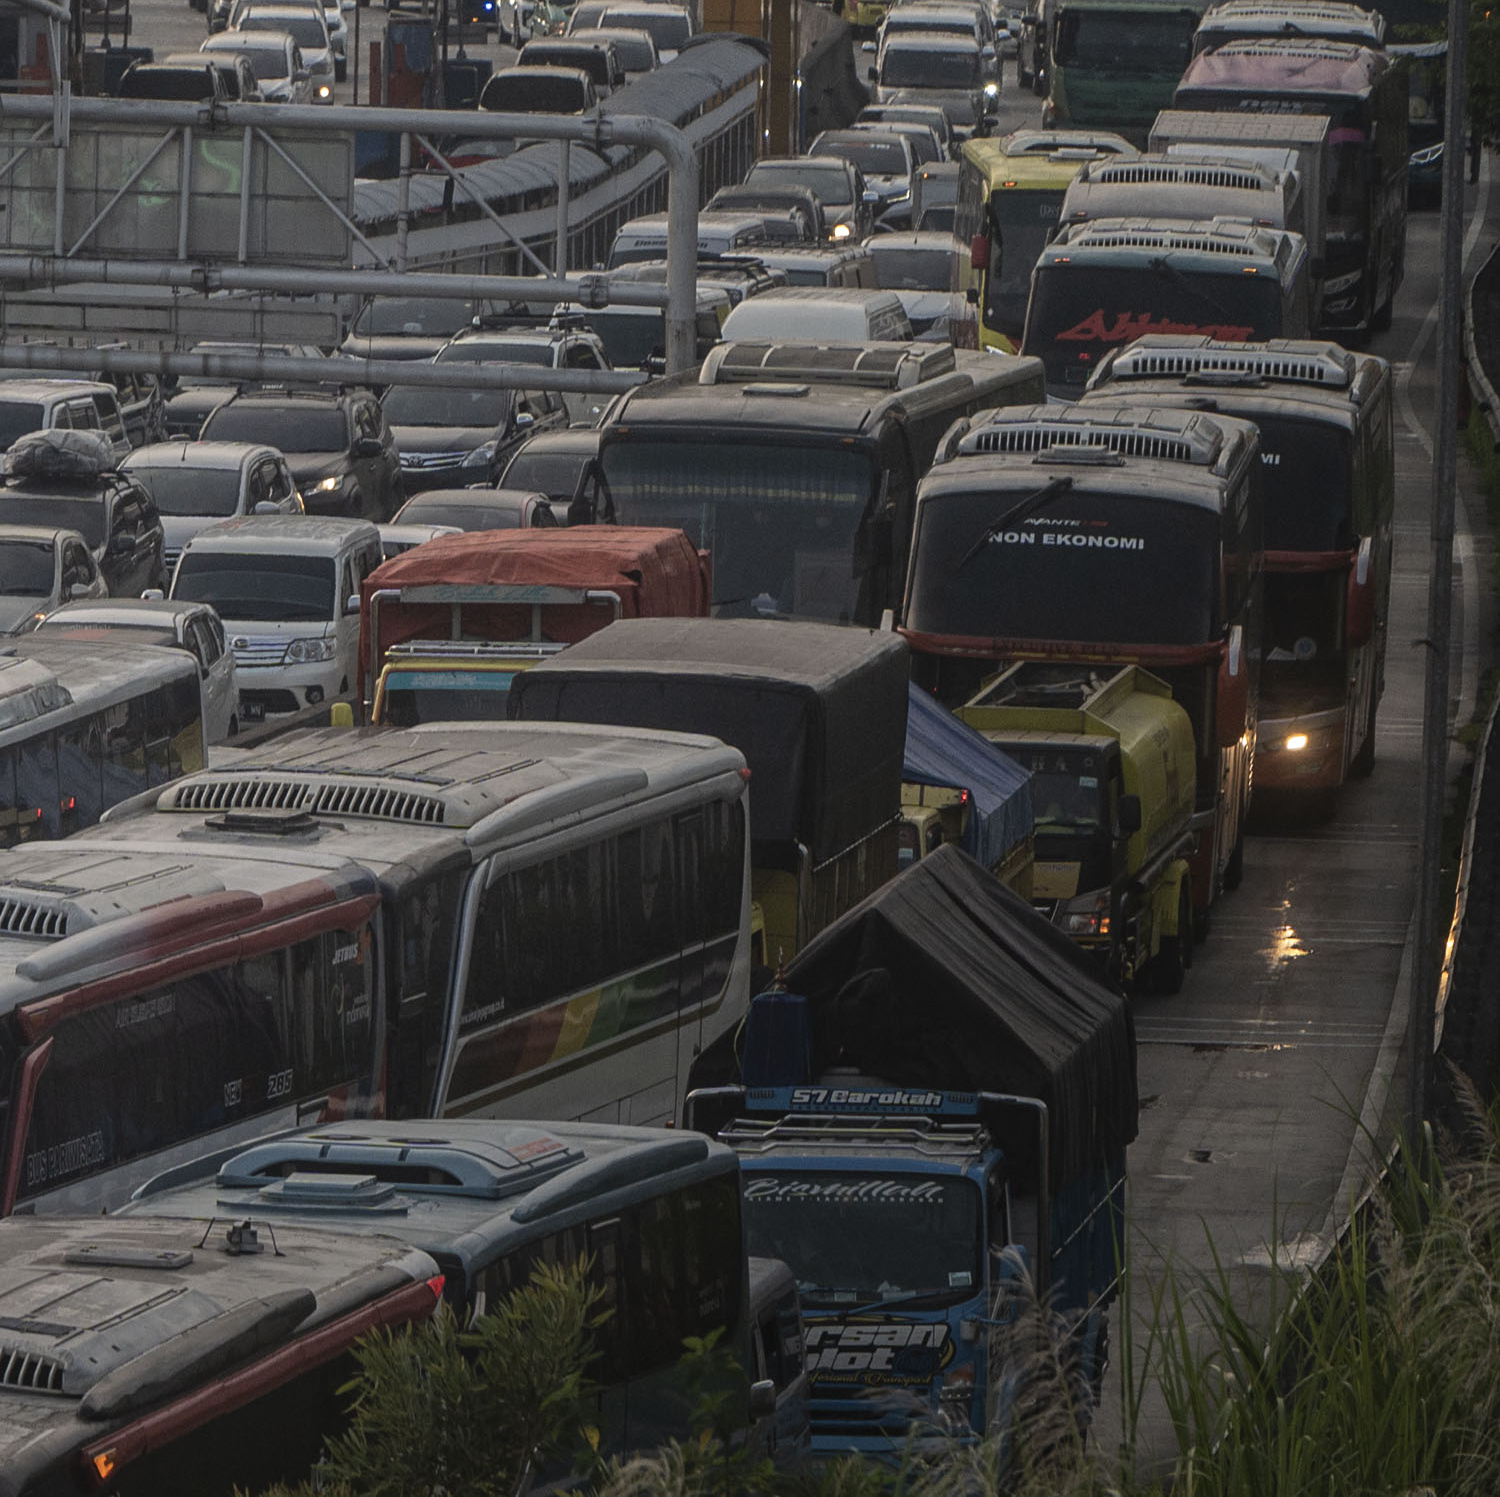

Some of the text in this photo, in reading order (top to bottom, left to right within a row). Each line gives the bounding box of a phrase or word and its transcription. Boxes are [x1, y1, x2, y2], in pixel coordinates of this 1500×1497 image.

[988, 530, 1145, 551] NON EKONOMI
[830, 1089, 944, 1109] Barokah
[26, 1149, 47, 1187] BUS
